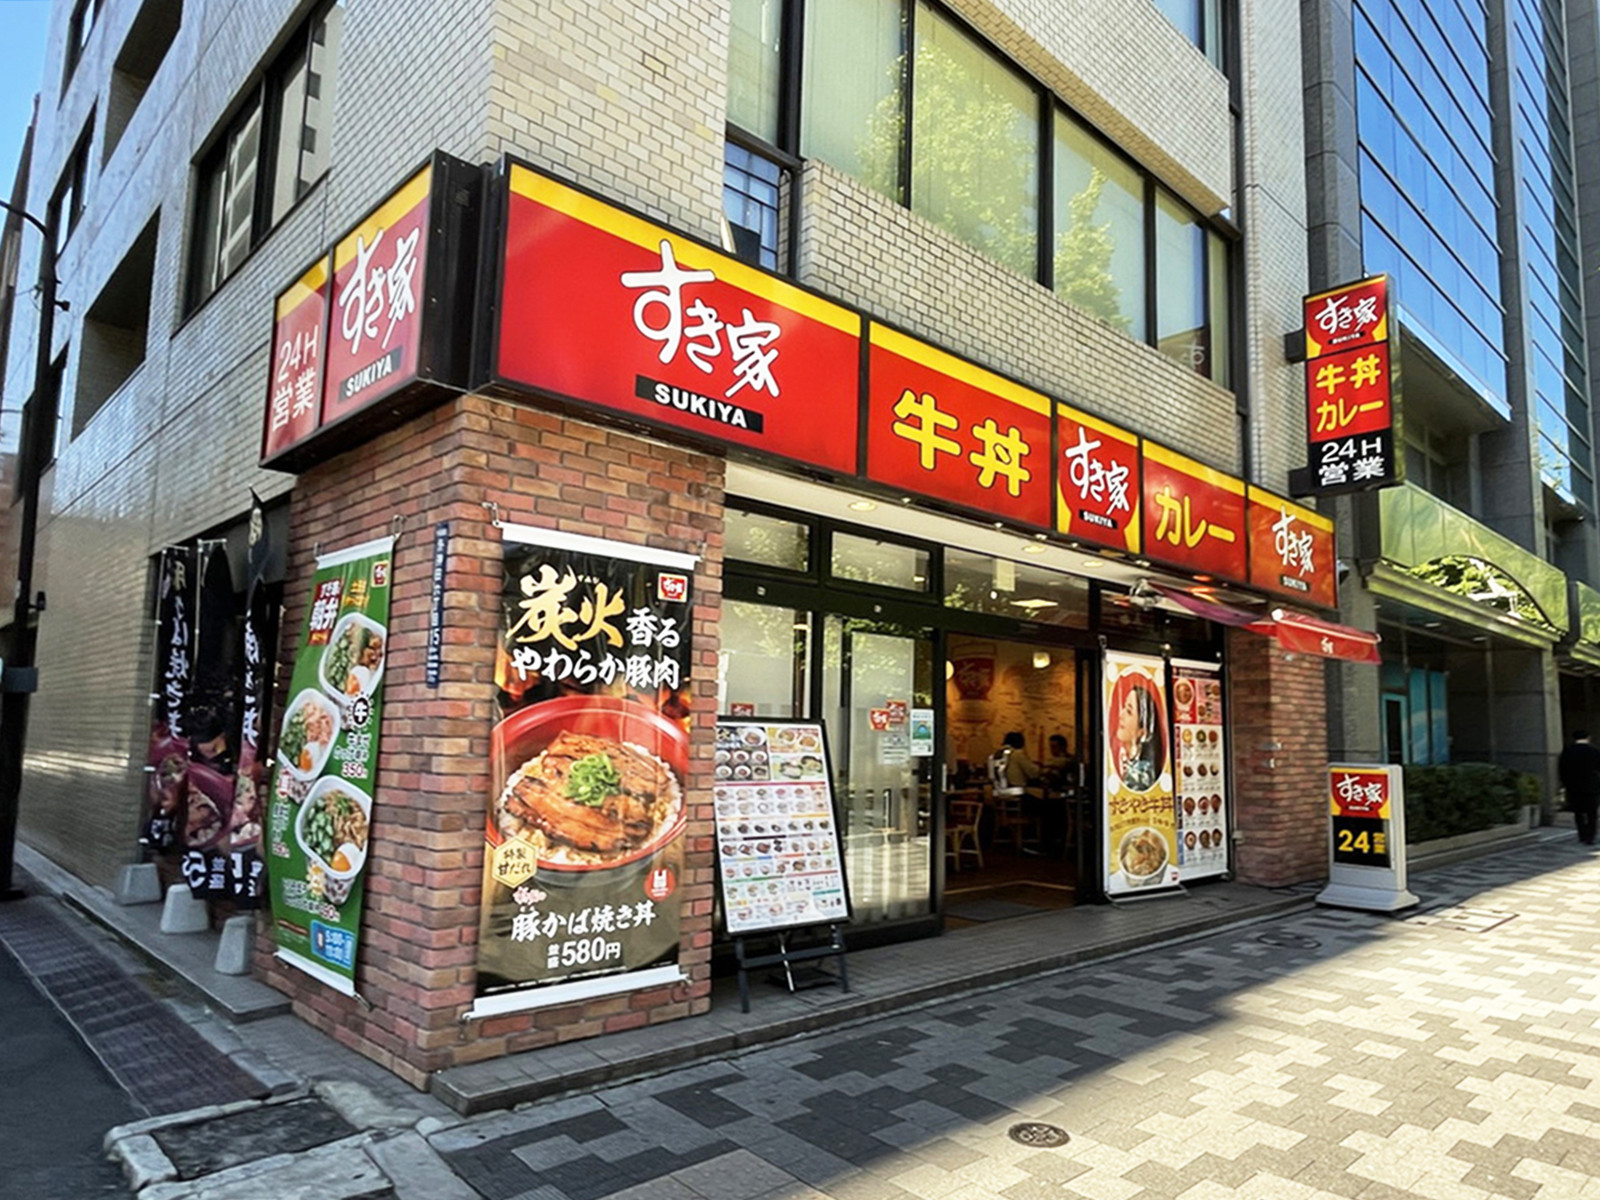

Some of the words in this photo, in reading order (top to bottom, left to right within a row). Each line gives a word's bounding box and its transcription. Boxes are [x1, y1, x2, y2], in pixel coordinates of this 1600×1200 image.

[339, 227, 420, 355] すき家
[620, 238, 781, 399] すき家
[1315, 295, 1379, 335] すき家
[278, 325, 319, 383] 24H
[345, 354, 393, 398] SUKIYA
[1315, 353, 1382, 395] 牛丼
[271, 369, 316, 432] 営業
[654, 383, 748, 429] SUKIYA
[1315, 397, 1384, 433] カレー
[893, 389, 1032, 498] 牛丼
[1321, 437, 1382, 464] 24H
[1065, 426, 1131, 516] すき家
[1318, 455, 1385, 487] 営業
[1154, 484, 1237, 550] カレー
[1272, 504, 1315, 579] すき家
[510, 646, 681, 691] やわらか豚肉
[1336, 773, 1383, 806] すき家
[510, 900, 657, 943] 豚かば焼き丼
